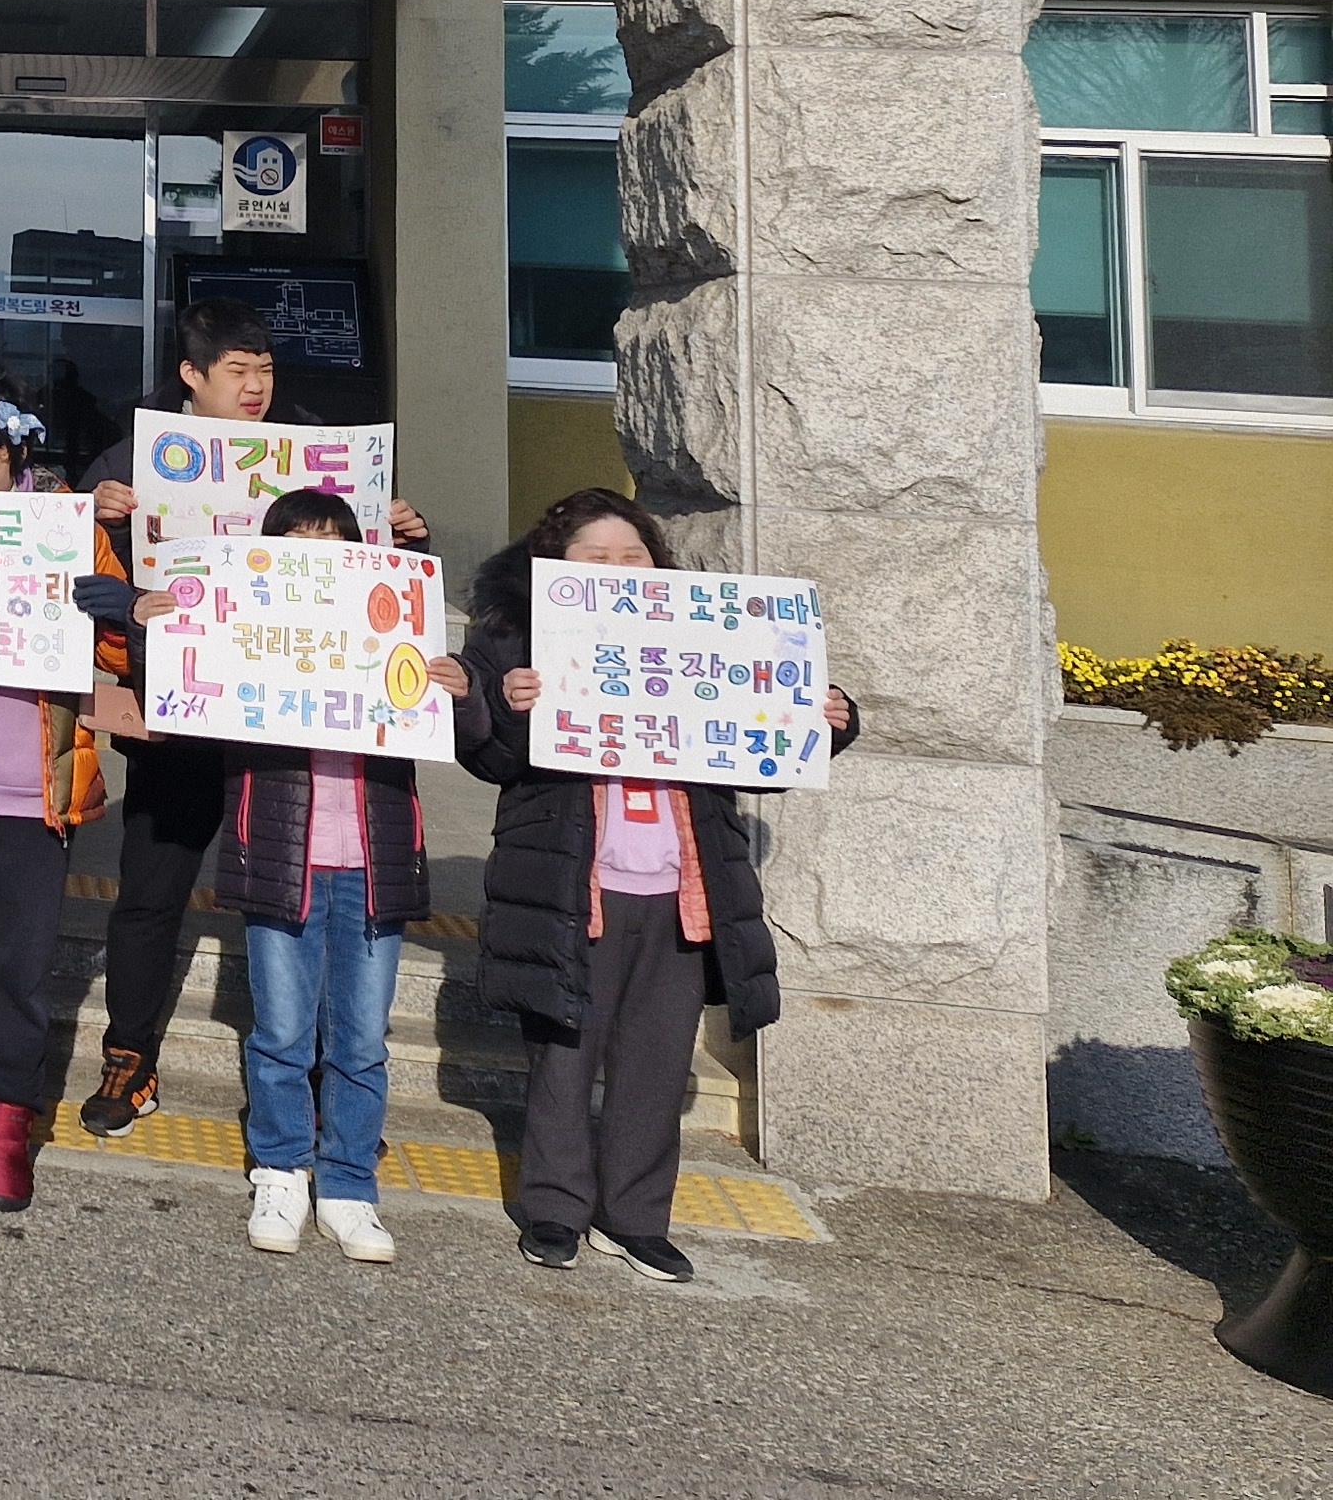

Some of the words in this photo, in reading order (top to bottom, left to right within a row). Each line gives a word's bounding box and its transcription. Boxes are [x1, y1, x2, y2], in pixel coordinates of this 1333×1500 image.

[238, 200, 289, 212] 금연시설
[49, 299, 84, 316] 옥천
[151, 430, 356, 499] 이것도
[246, 547, 336, 606] 옥천군
[342, 548, 382, 570] 군수님
[548, 576, 674, 622] 이것도
[690, 581, 822, 631] 노동이다!
[232, 623, 349, 674] 권리중심
[593, 643, 813, 706] 중증장애인
[237, 681, 364, 730] 일자리
[555, 709, 680, 768] 노동권
[705, 719, 820, 777] 보장!
